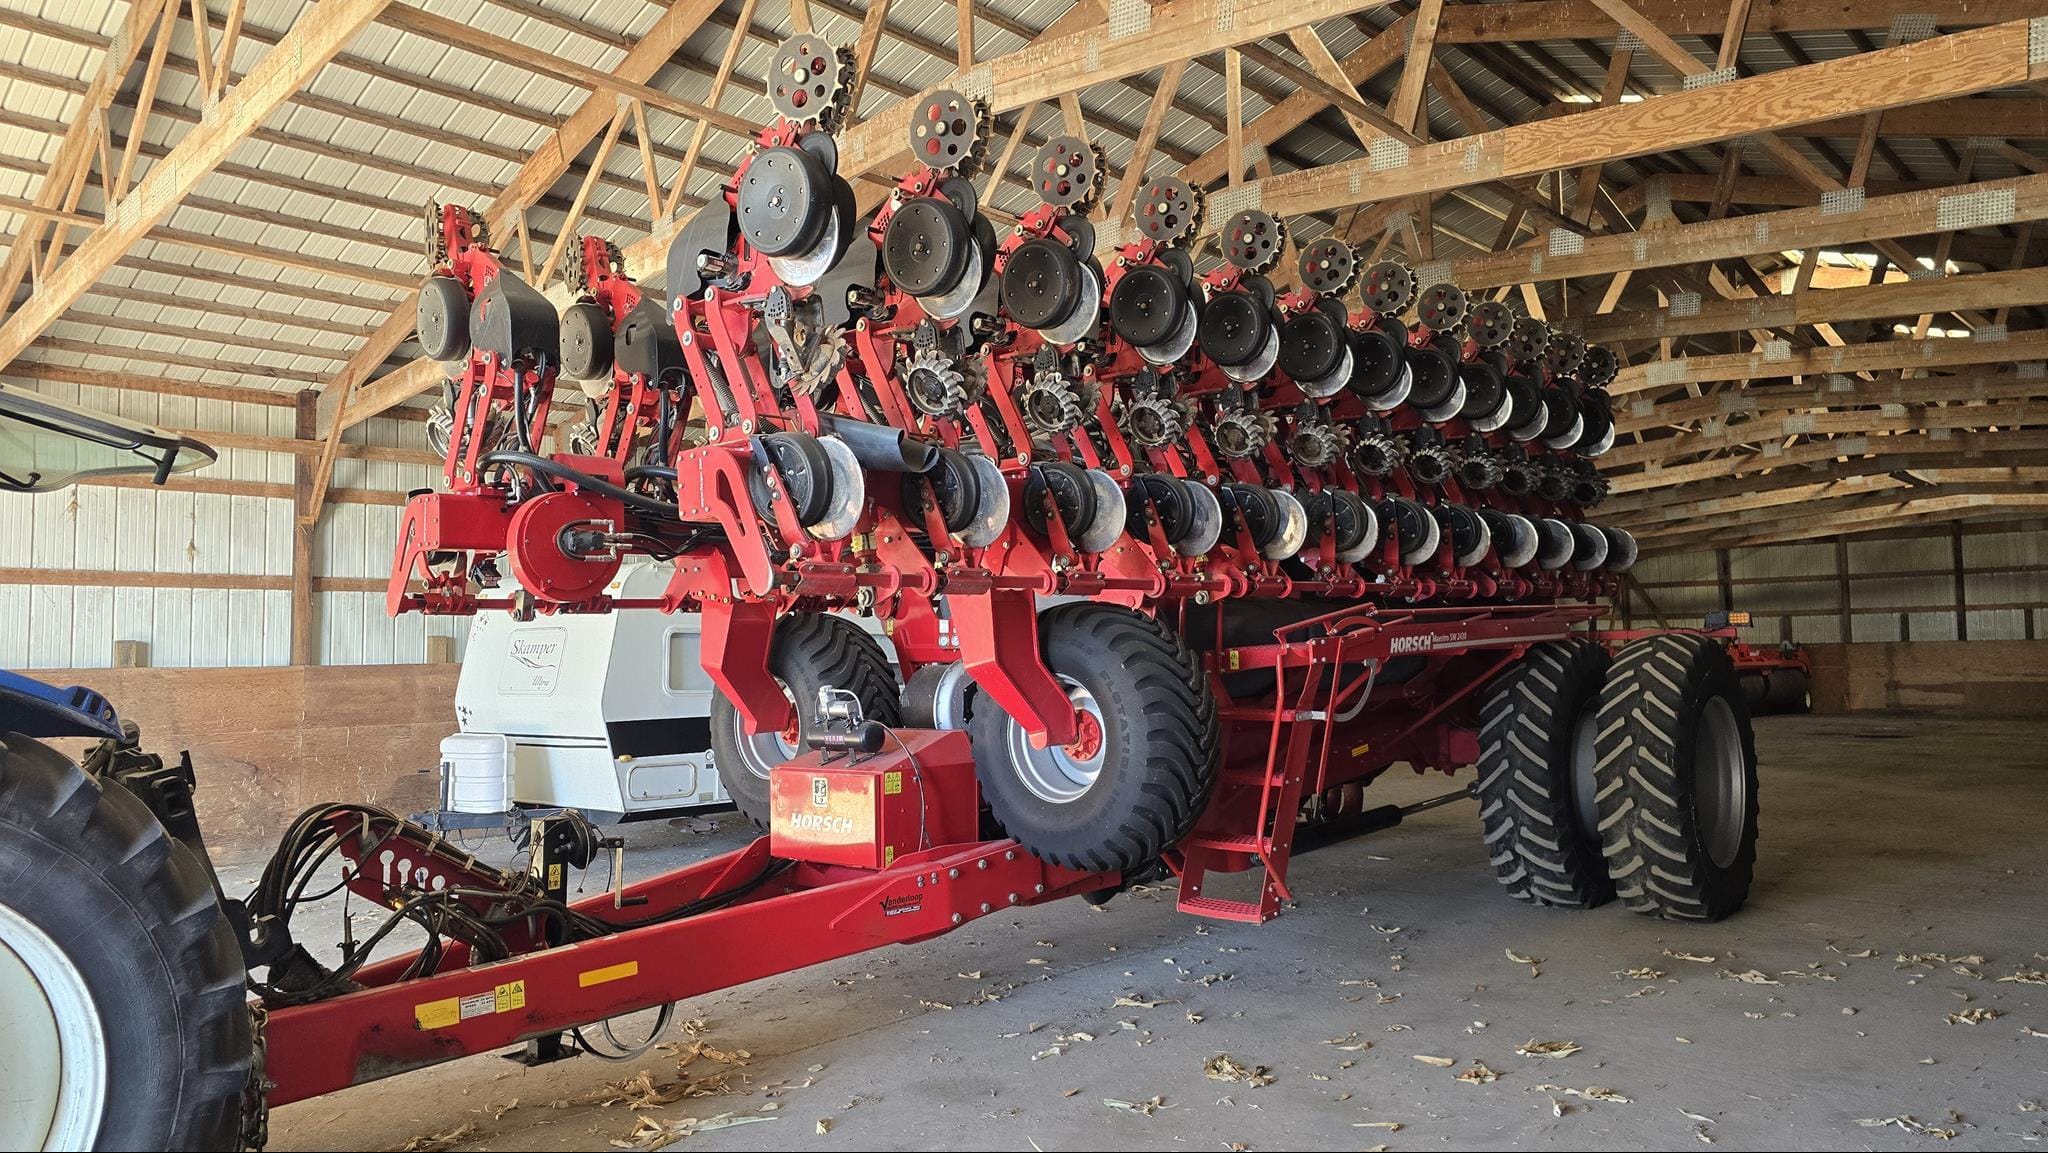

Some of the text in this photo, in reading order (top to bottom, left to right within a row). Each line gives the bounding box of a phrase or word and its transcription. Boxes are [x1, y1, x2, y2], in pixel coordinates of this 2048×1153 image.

[511, 639, 557, 659] Skamper
[1390, 635, 1431, 653] HORSCH
[1100, 670, 1130, 783] FLOTATION
[790, 813, 853, 833] HORSCH
[880, 893, 923, 911] Vanderloop
